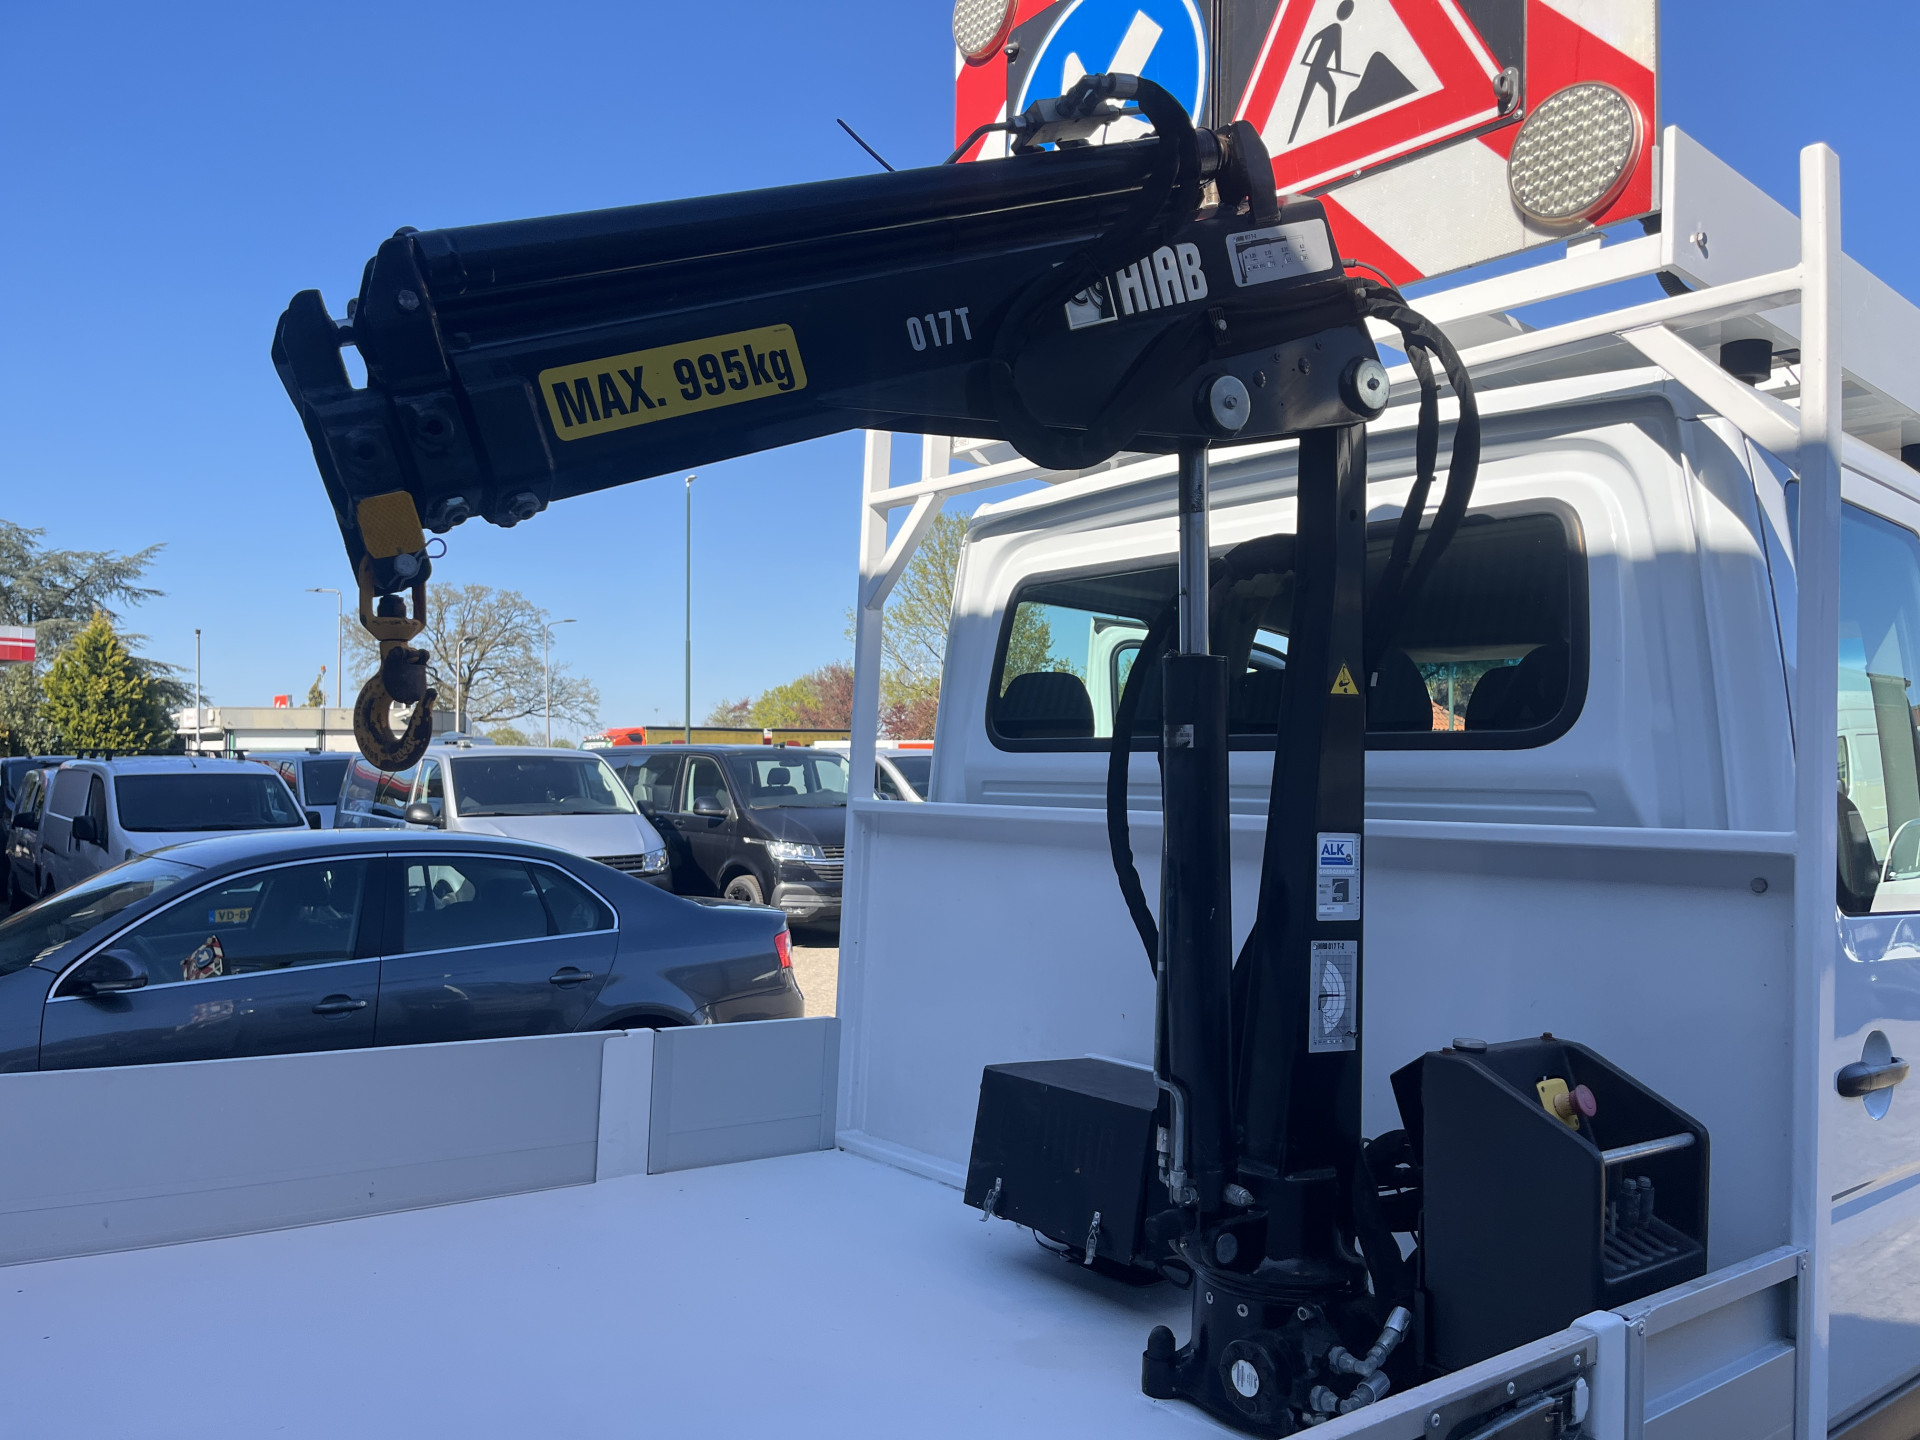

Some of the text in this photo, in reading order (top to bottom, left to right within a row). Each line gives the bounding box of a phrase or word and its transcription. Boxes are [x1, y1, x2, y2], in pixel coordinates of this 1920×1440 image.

[1116, 242, 1208, 315] HIAB
[906, 307, 972, 350] 017T
[551, 344, 794, 428] MAX. 995kg
[1321, 843, 1345, 855] ALK
